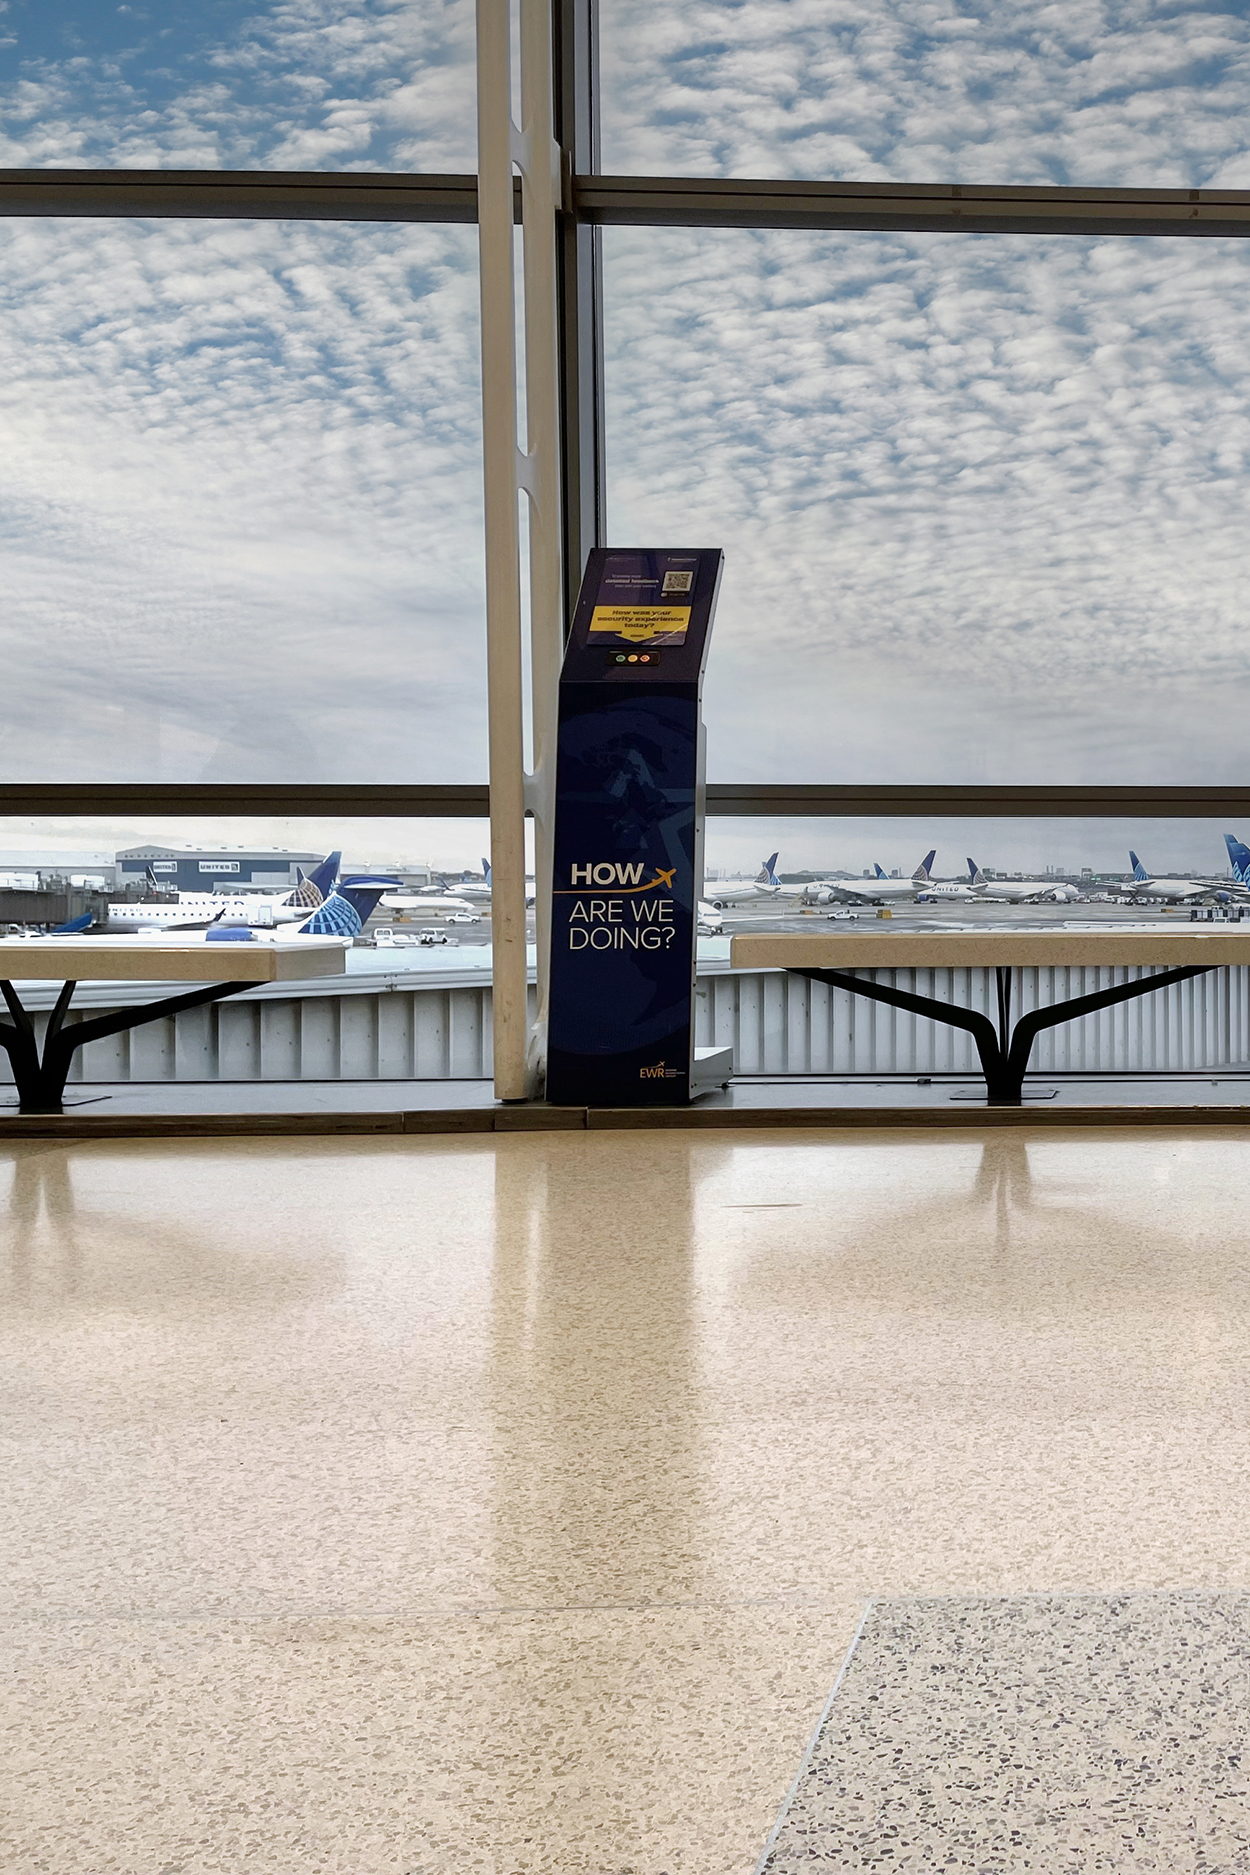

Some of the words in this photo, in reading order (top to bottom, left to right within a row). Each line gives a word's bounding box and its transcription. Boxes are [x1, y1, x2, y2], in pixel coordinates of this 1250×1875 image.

[571, 862, 645, 885] HOW
[568, 900, 624, 923] ARE
[630, 899, 674, 922] WE
[569, 926, 676, 950] DOING?
[639, 1068, 665, 1079] EWR
